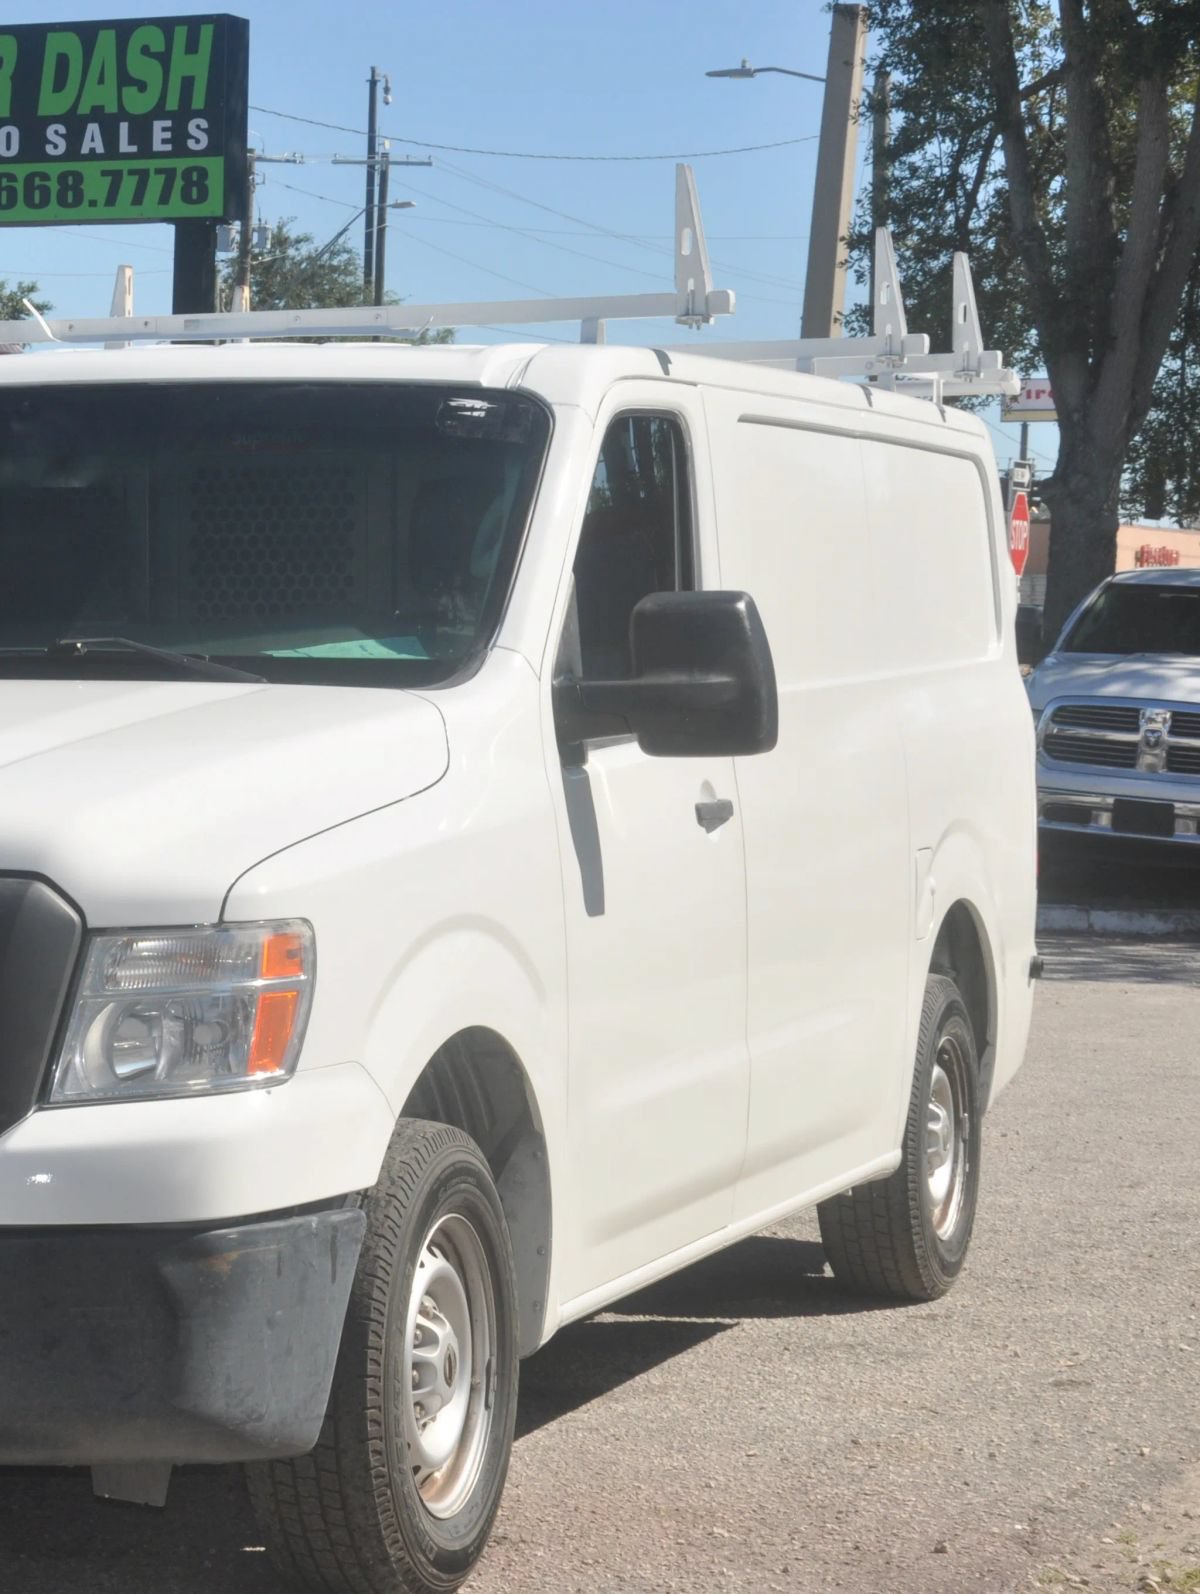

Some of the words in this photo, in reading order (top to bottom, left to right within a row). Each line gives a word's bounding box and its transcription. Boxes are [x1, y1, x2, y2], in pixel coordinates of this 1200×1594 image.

[37, 24, 214, 116] DASH
[45, 118, 209, 156] SALES
[1010, 519, 1028, 551] STOP
